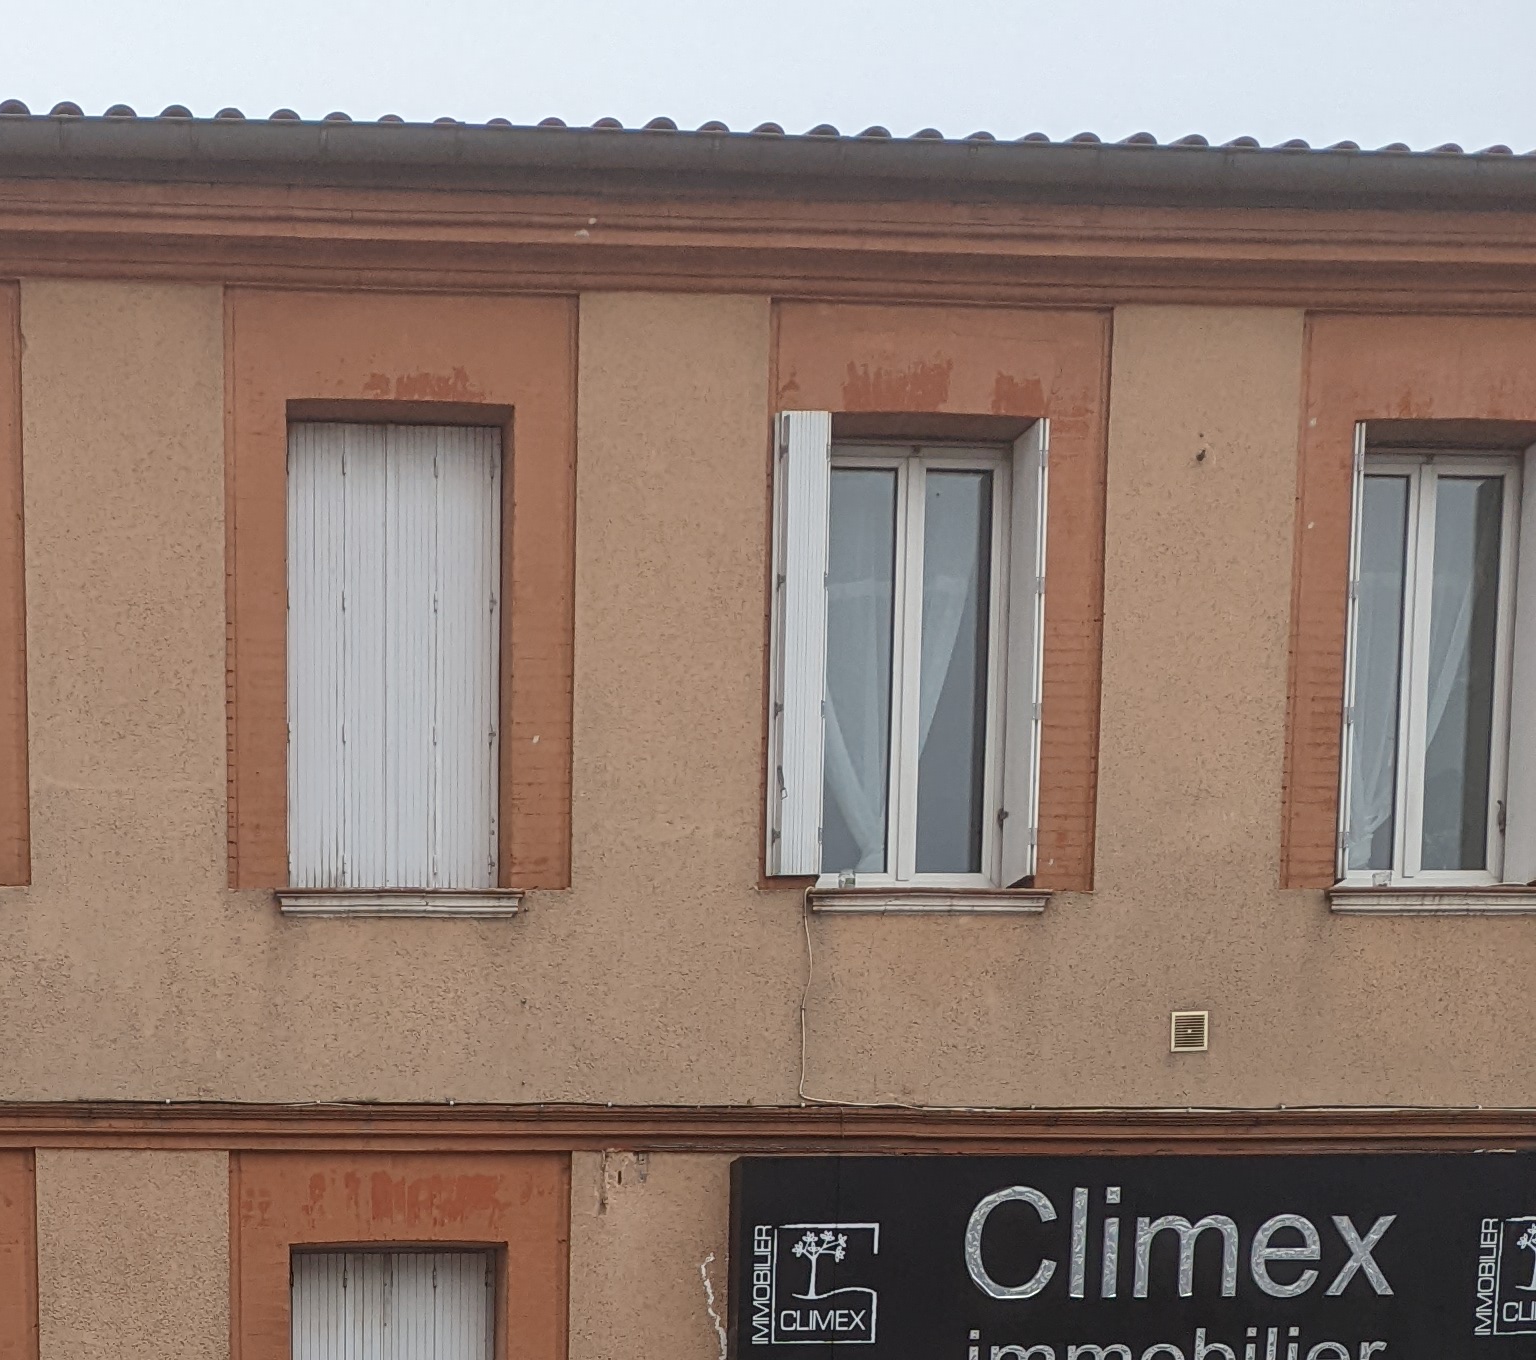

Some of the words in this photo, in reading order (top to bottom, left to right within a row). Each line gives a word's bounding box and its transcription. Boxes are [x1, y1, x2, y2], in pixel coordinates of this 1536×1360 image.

[751, 1225, 772, 1345] IMMOBILIER
[964, 1185, 1398, 1300] Climex
[1473, 1218, 1499, 1336] IMMOBILIER
[780, 1309, 867, 1331] CLIMEX
[1502, 1301, 1536, 1322] CLI
